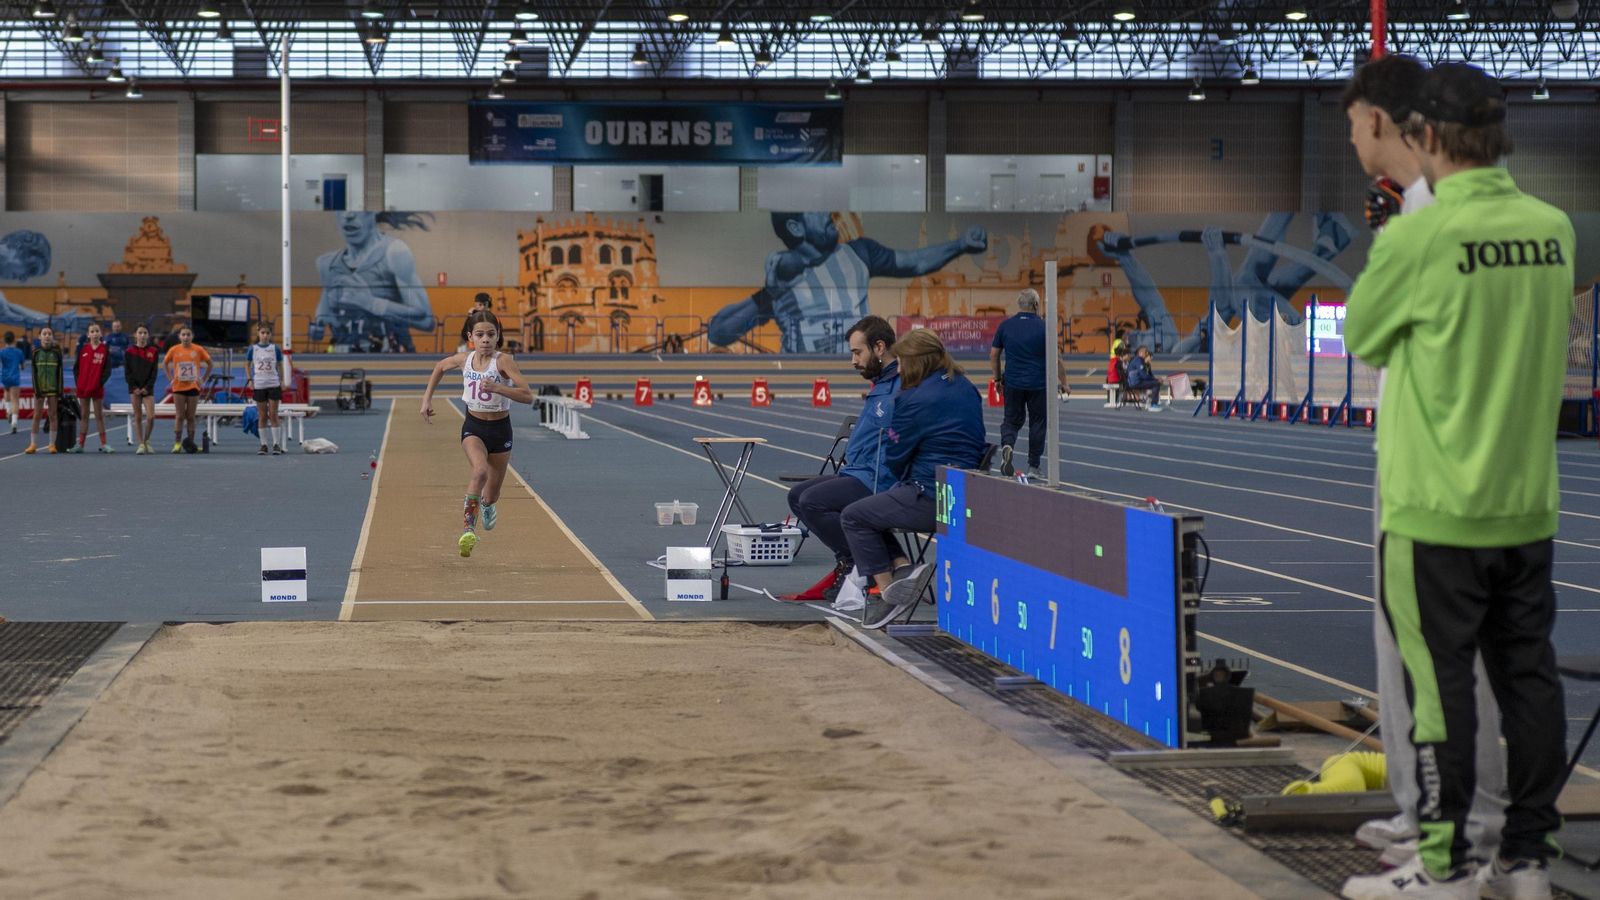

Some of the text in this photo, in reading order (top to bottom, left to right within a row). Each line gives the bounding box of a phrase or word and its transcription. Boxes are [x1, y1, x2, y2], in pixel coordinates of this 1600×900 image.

[586, 121, 733, 146] OURENSE
[930, 319, 989, 330] CLUB OURENSE
[939, 330, 982, 340] ATLETISMO
[181, 366, 193, 377] 21
[258, 361, 272, 371] 23
[579, 386, 590, 401] 8
[639, 386, 649, 401] 7
[697, 386, 708, 401] 6
[756, 386, 766, 401] 5
[816, 386, 827, 401] 4
[944, 560, 1132, 685] 5 50 6 50 7 50 8
